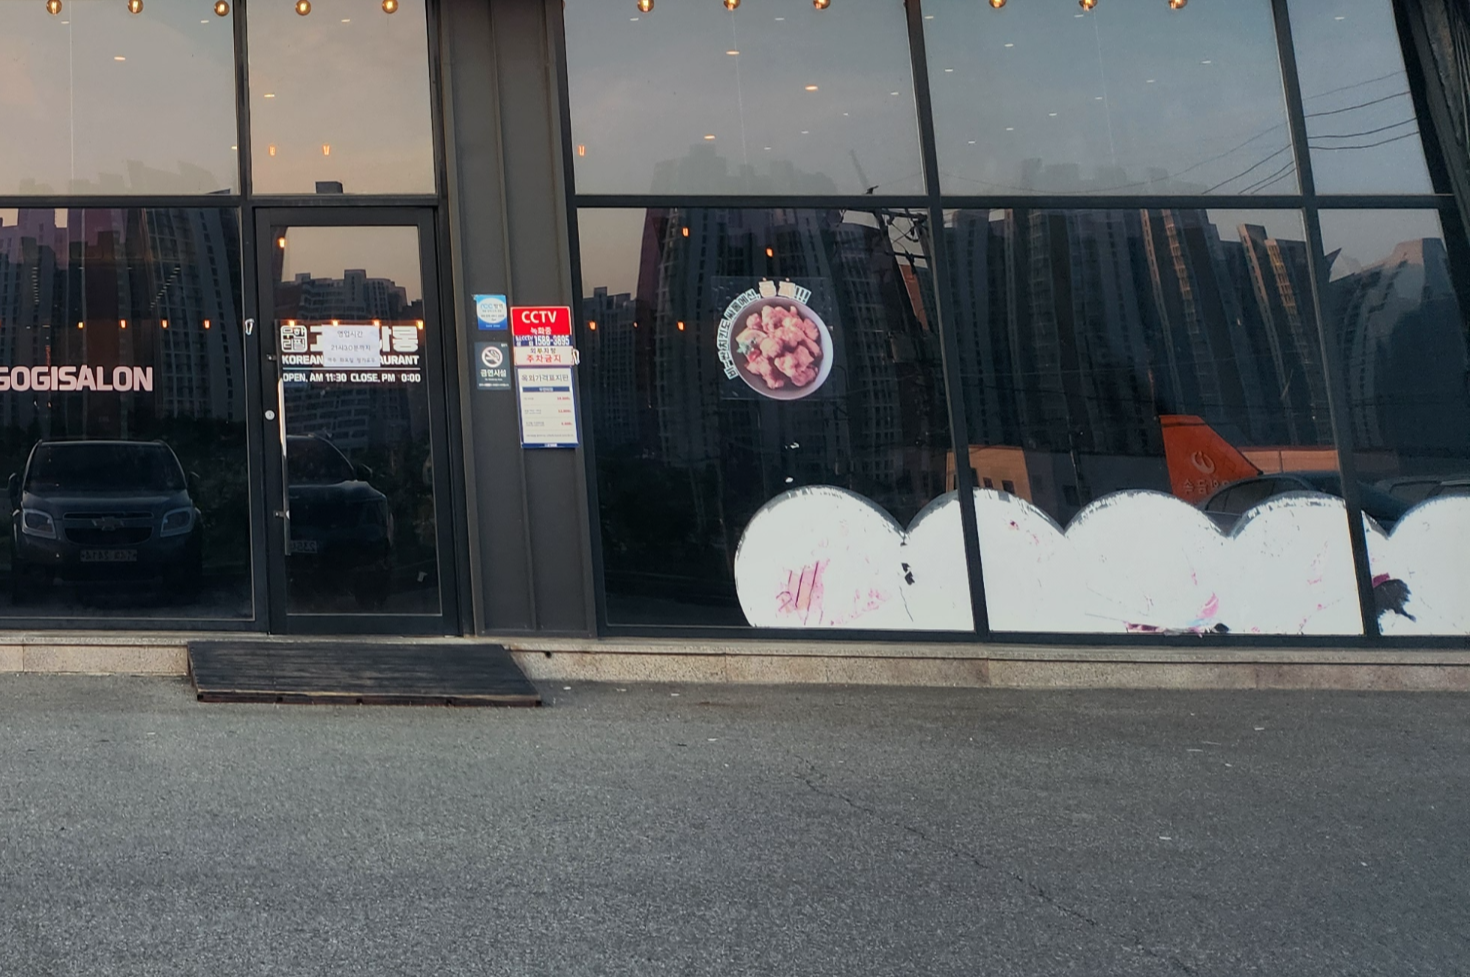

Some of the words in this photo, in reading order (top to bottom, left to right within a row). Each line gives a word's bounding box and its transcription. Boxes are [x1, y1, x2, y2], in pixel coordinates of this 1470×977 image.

[521, 310, 557, 324] CCTV
[281, 355, 324, 365] KOREAN
[527, 354, 561, 364] 주차금지
[310, 373, 323, 382] AM
[325, 373, 347, 382] 11:30
[382, 373, 396, 382] PM
